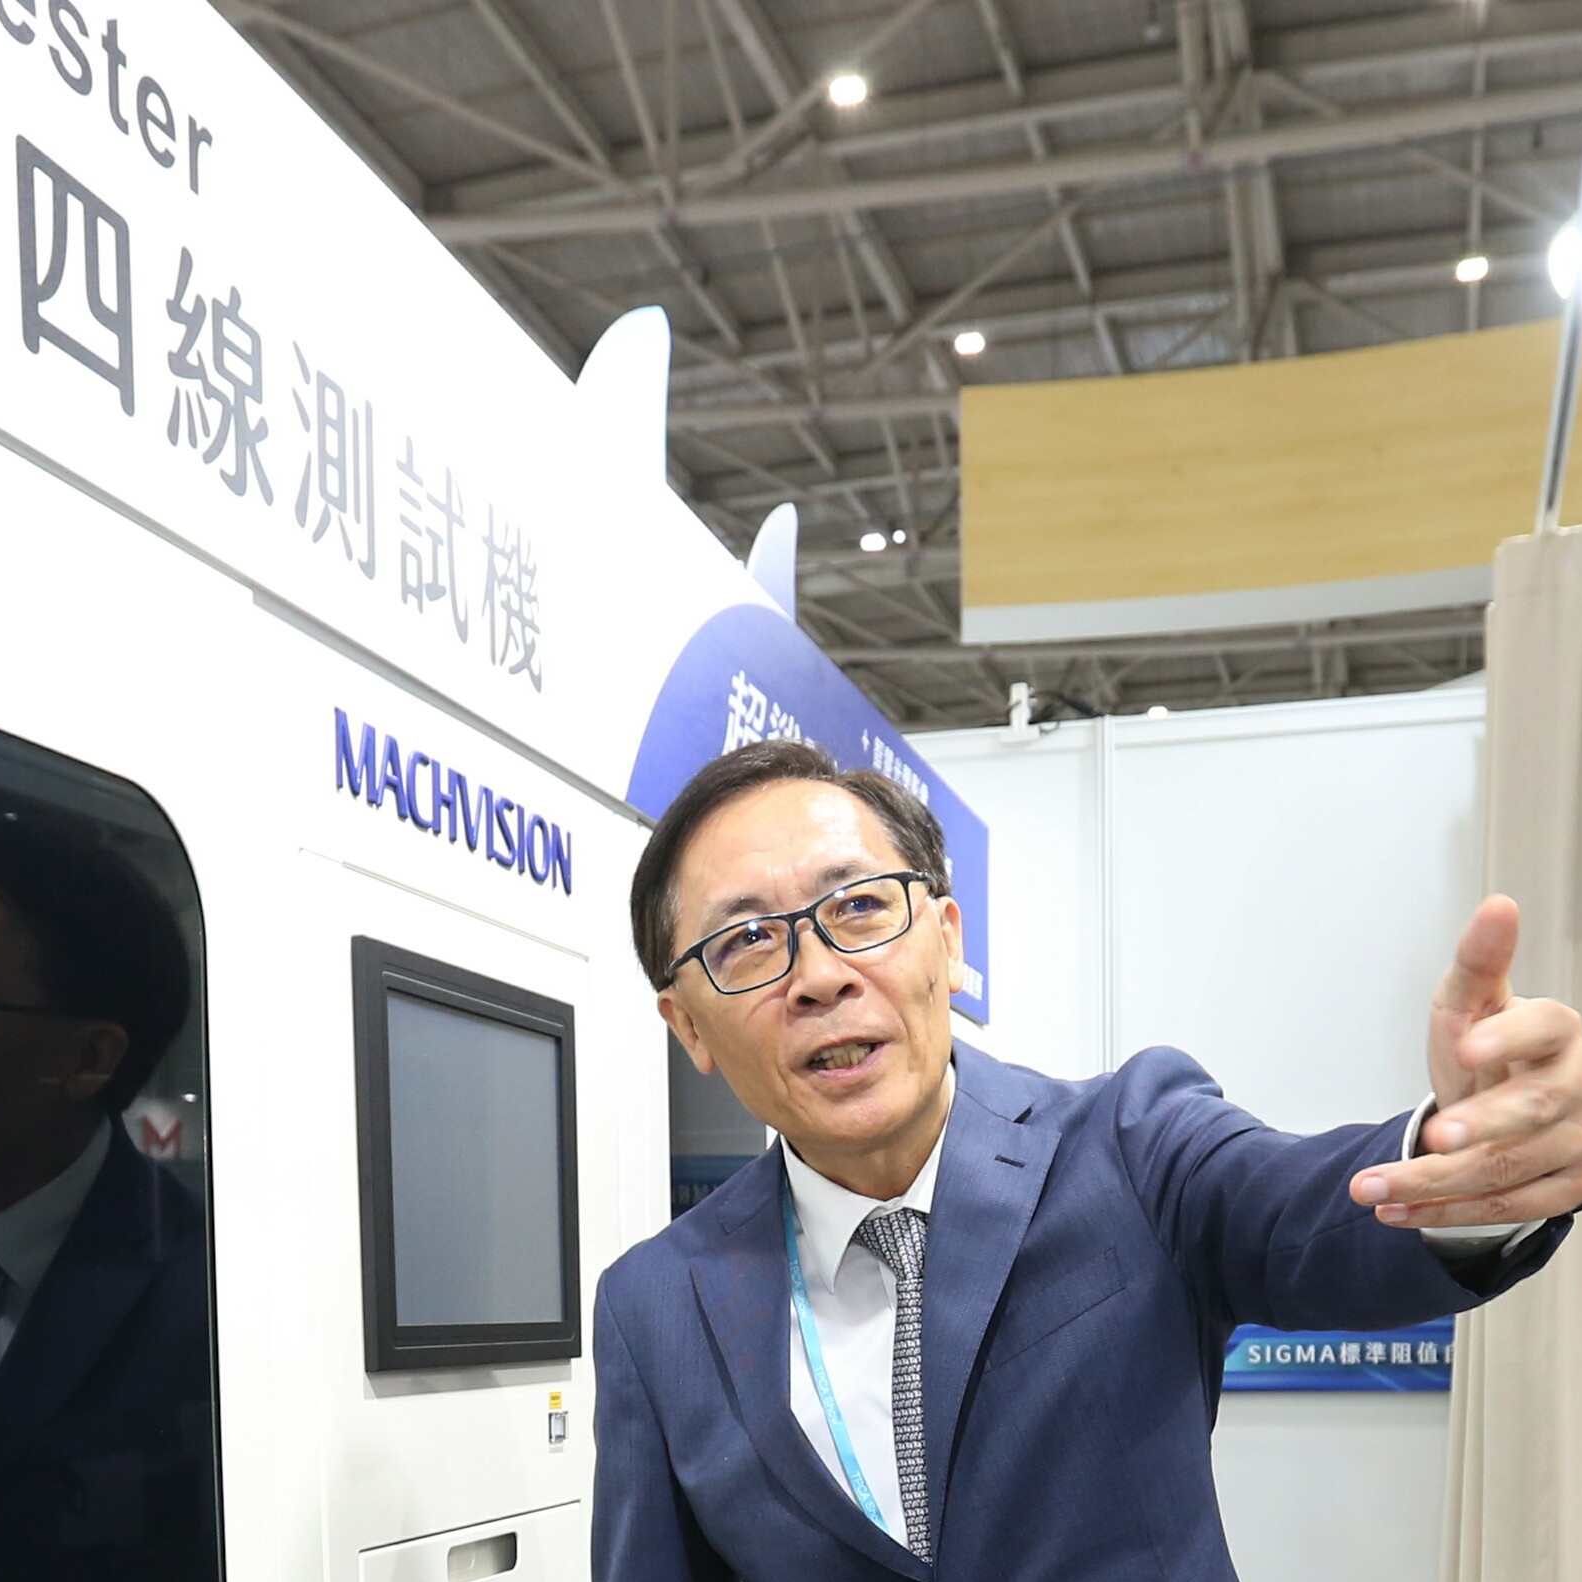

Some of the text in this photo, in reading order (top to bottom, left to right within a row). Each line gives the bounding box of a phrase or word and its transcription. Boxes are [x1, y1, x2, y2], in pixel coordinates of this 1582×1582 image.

[334, 706, 571, 896] MACHVISION
[814, 1366, 840, 1425] TPCA Show
[851, 1473, 870, 1503] TPCA
